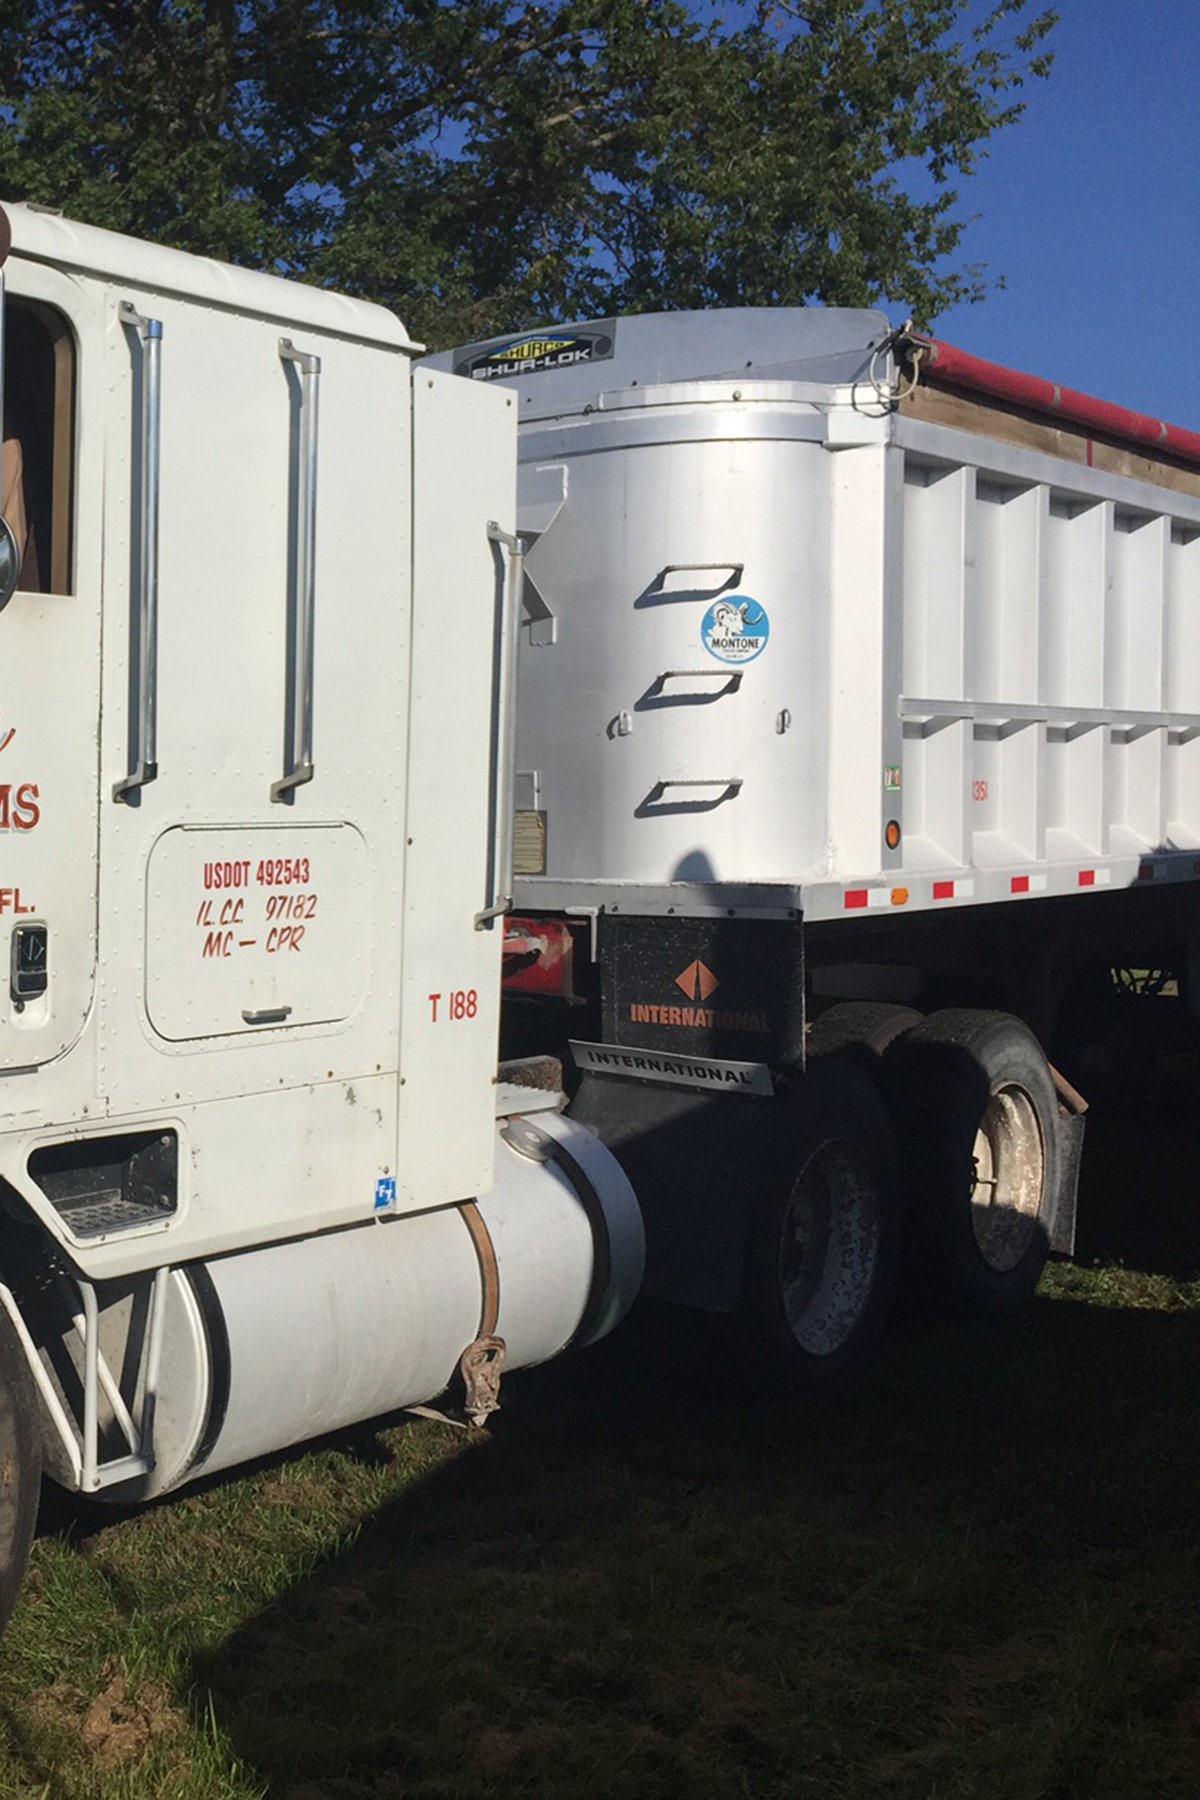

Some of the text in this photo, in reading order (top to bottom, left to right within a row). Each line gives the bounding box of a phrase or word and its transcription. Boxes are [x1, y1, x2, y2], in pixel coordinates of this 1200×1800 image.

[471, 347, 591, 379] SHUR-LOK
[711, 637, 760, 649] MONTONE
[204, 858, 310, 890] USDOT 492543
[265, 894, 318, 921] 97182
[428, 990, 478, 1022] T 188
[587, 1051, 753, 1085] INTERNATIONAL
